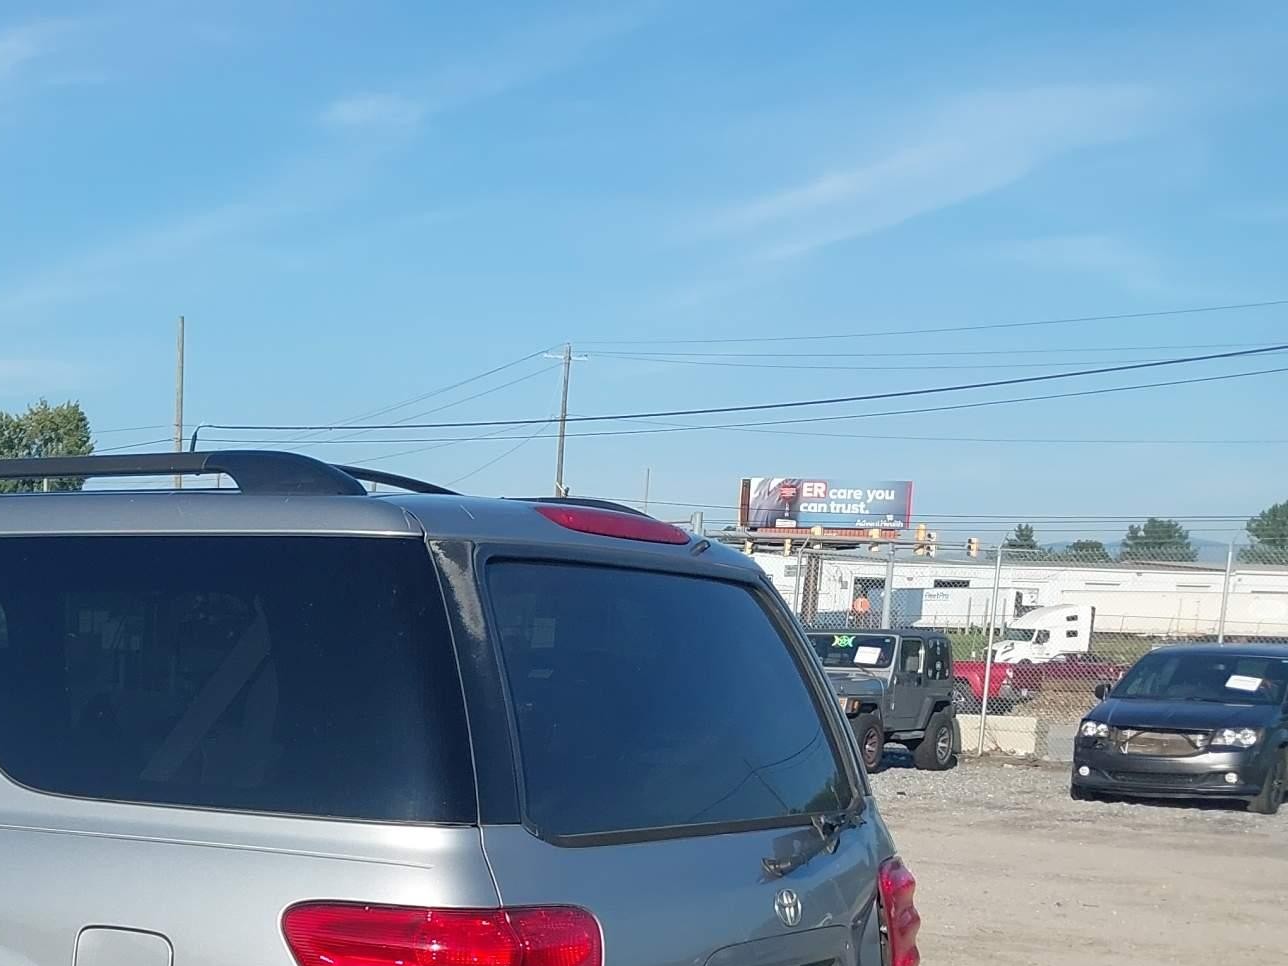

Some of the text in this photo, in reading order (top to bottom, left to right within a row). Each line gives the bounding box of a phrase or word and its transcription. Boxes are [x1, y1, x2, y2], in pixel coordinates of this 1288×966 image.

[802, 482, 826, 498] ER
[829, 488, 863, 500] care
[866, 489, 895, 503] you
[799, 501, 869, 514] can trust.
